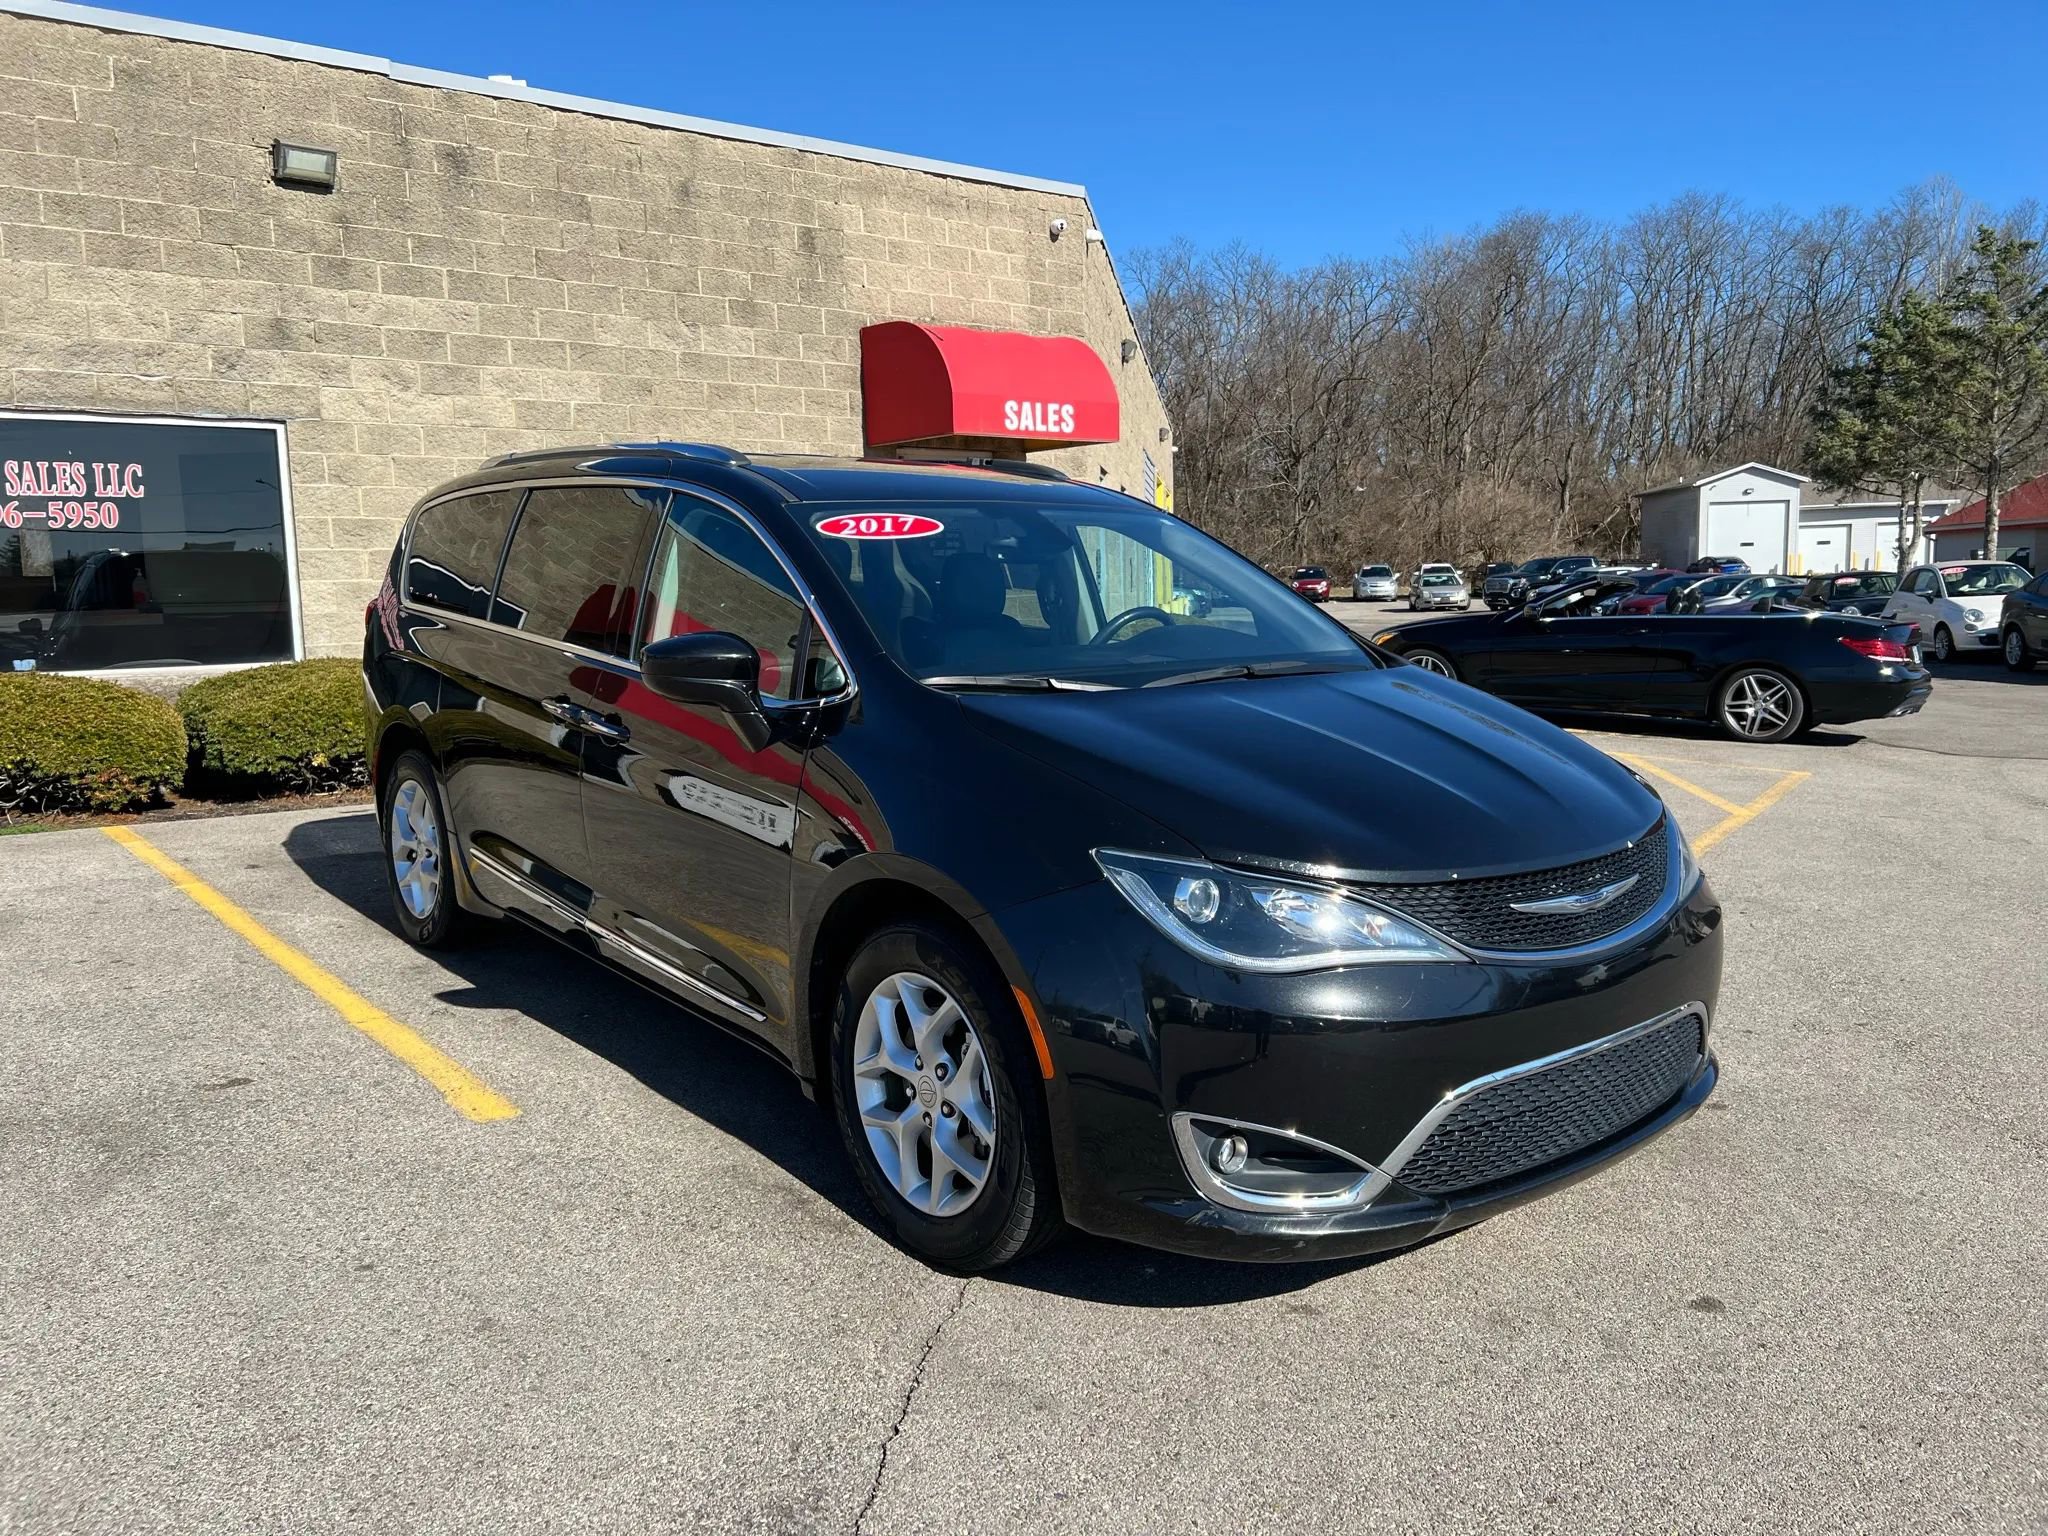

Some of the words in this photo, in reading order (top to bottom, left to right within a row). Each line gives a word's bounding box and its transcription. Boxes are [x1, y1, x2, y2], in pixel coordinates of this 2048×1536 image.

[1003, 400, 1075, 434] SALES
[4, 460, 87, 497] SALES
[92, 463, 145, 498] LLC
[0, 500, 119, 529] 6-5950
[839, 516, 916, 536] 2017
